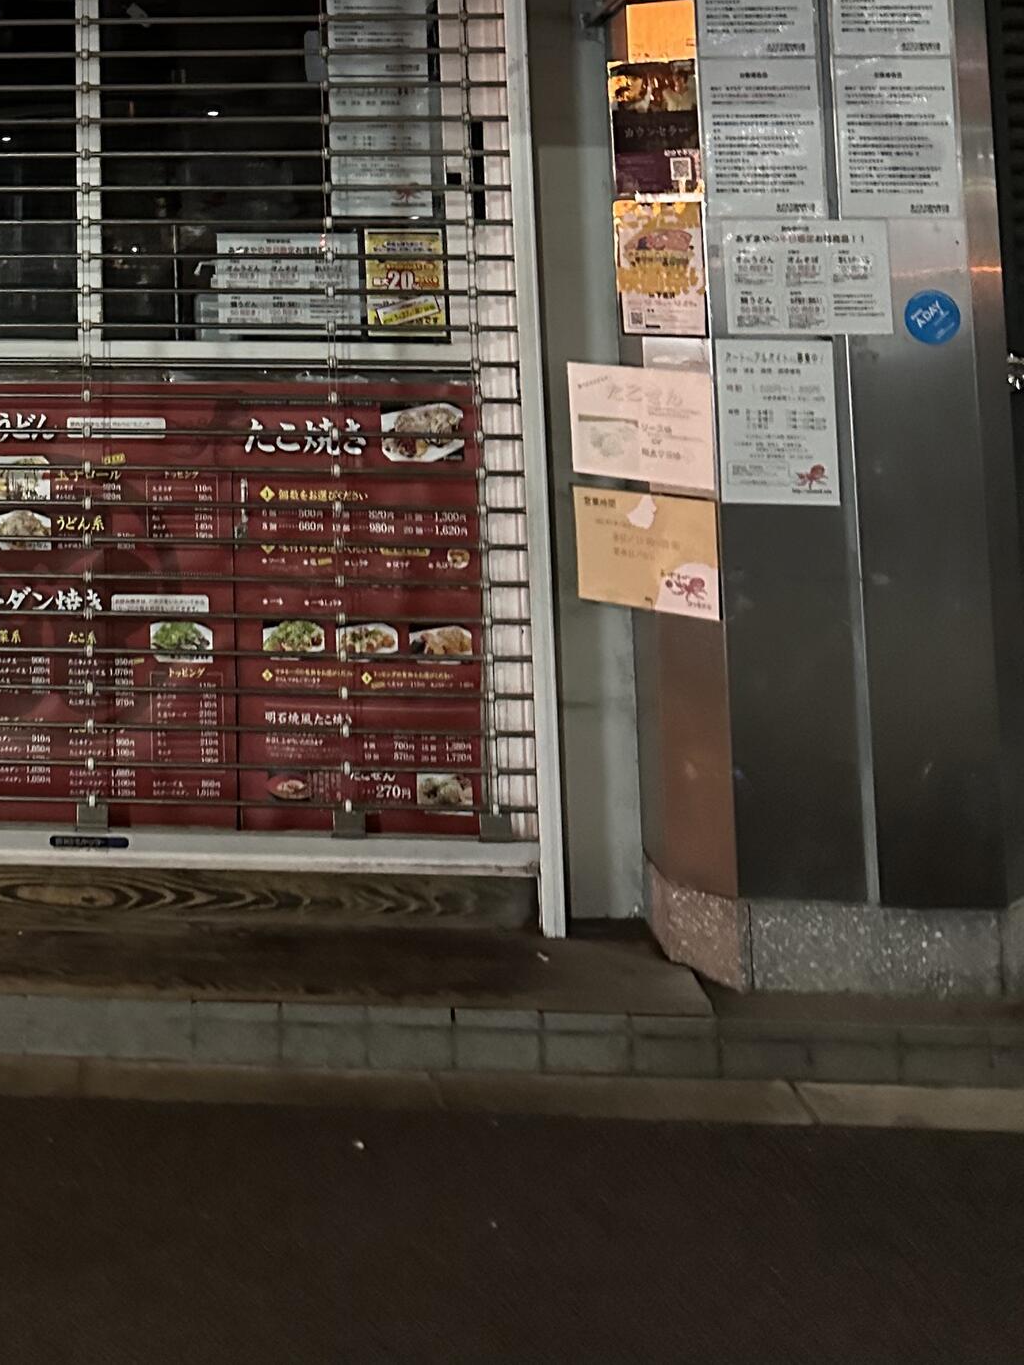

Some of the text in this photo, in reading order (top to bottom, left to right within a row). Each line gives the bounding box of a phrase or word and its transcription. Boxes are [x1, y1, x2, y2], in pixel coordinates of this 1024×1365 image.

[244, 417, 367, 455] たこ焼き
[56, 515, 105, 531] うどん系
[376, 784, 412, 799] 270円
